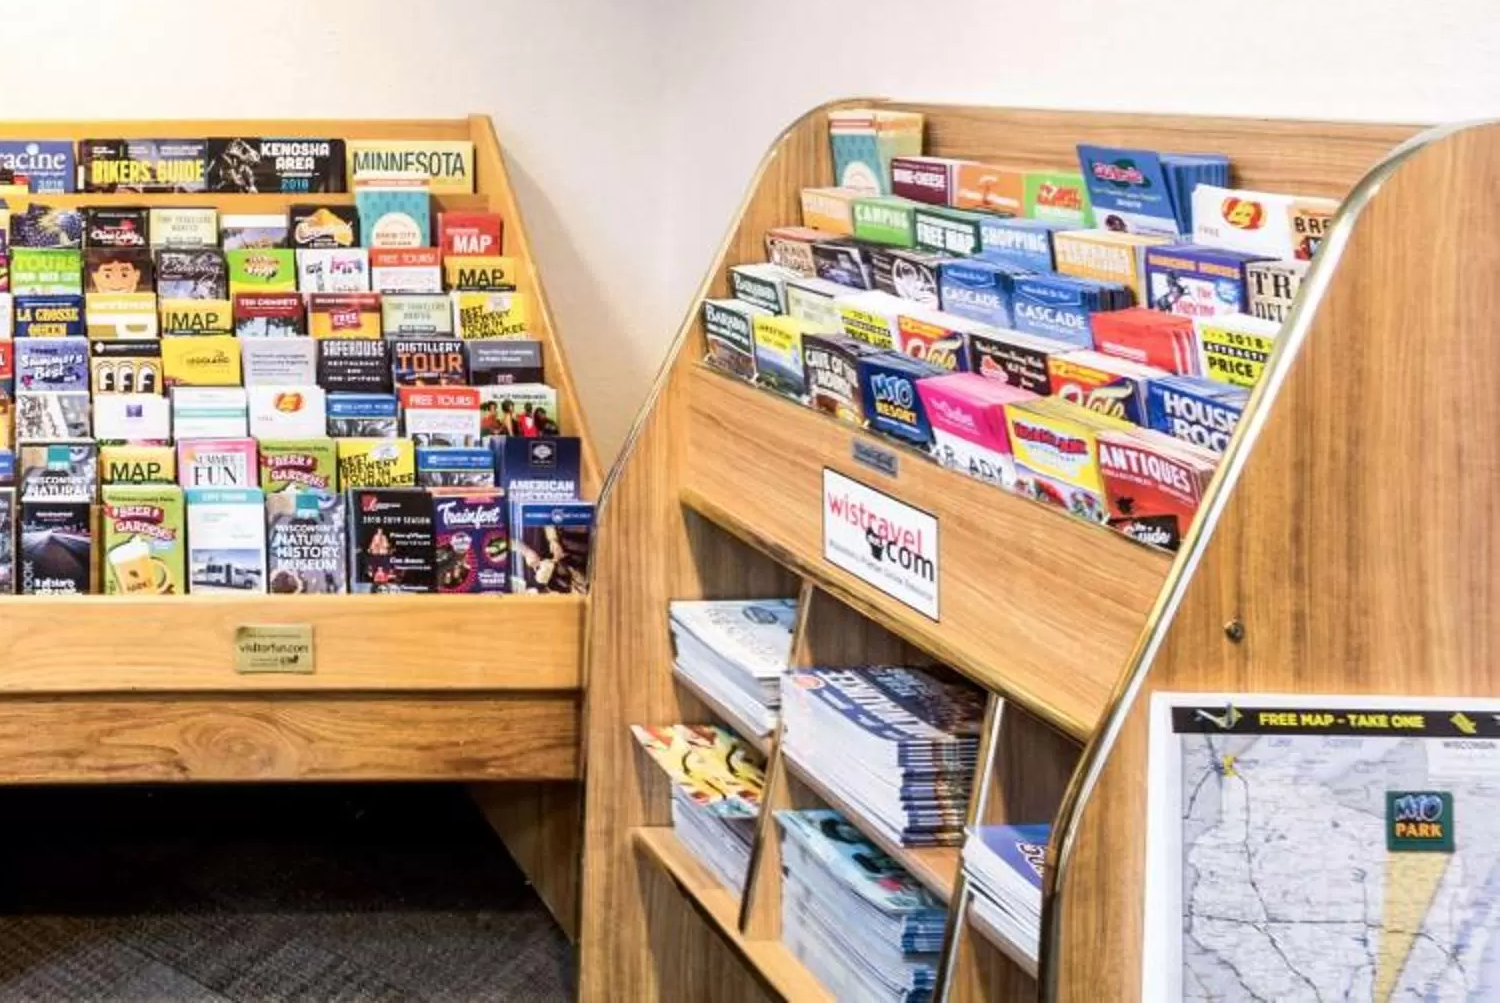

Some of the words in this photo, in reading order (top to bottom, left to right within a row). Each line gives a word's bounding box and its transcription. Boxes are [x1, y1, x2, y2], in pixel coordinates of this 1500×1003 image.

[260, 142, 330, 156] KENOSHA
[92, 160, 150, 184] BIKERS
[156, 160, 205, 182] GUIDE
[275, 156, 315, 170] AREA
[353, 151, 466, 178] MINNESOTA
[452, 235, 493, 254] MAP
[458, 268, 505, 287] MAP
[942, 286, 1001, 307] CASCADE
[16, 308, 33, 321] LA
[170, 312, 219, 330] MAP
[1015, 302, 1086, 330] CASCADE
[395, 342, 461, 353] DISTILLERY
[1226, 332, 1264, 349] 2018
[1206, 344, 1268, 362] ATTRACTI
[398, 353, 464, 373] TOUR
[1208, 356, 1254, 378] PRICE
[409, 394, 433, 406] FREE
[109, 462, 161, 481] MAP
[193, 466, 238, 486] FUN
[1100, 443, 1192, 494] ANTIQUES
[508, 480, 575, 491] AMERICAN
[119, 506, 152, 518] BEER
[437, 500, 501, 530] Trainfest
[115, 519, 176, 541] GARDENS
[827, 491, 923, 555] wistravel
[273, 533, 339, 546] NATURAL
[276, 546, 340, 558] HISTORY
[277, 558, 337, 570] MUSEUM
[1259, 712, 1298, 726] FREE
[1300, 713, 1334, 727] MAP
[1347, 714, 1389, 728] TAKE
[1394, 715, 1425, 728] ONE
[1395, 823, 1443, 838] PARK
